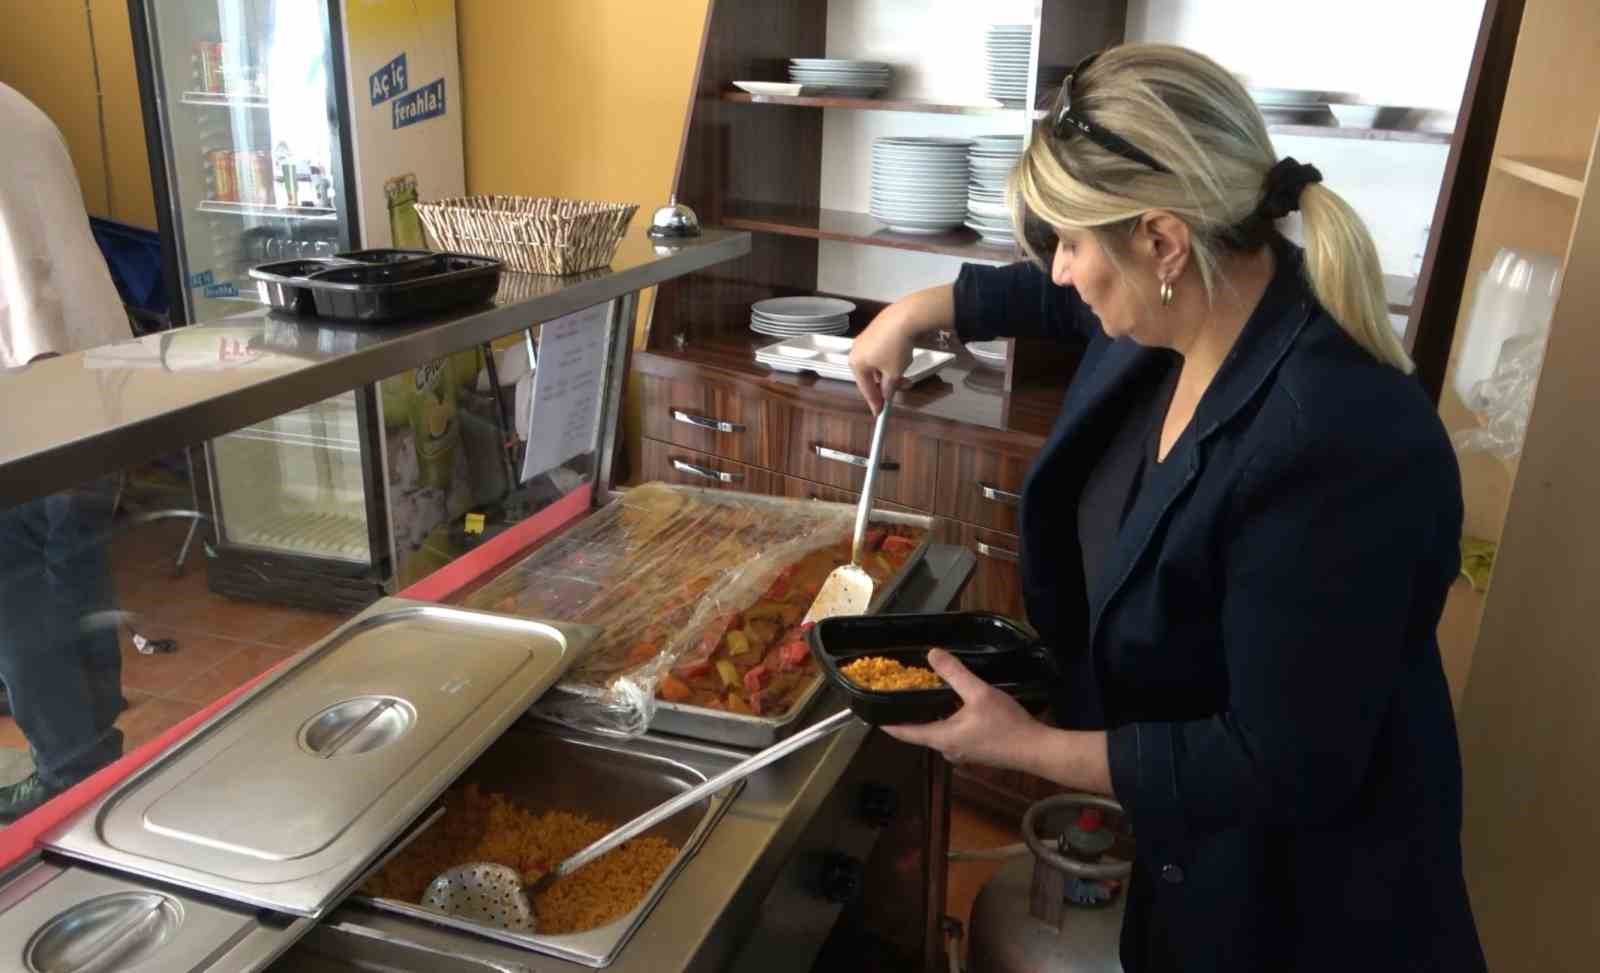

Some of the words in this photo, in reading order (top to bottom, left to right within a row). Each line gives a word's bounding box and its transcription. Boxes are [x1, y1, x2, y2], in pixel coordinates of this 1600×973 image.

[372, 73, 390, 99] Aç
[391, 62, 404, 91] iç
[394, 84, 443, 129] ferahla!
